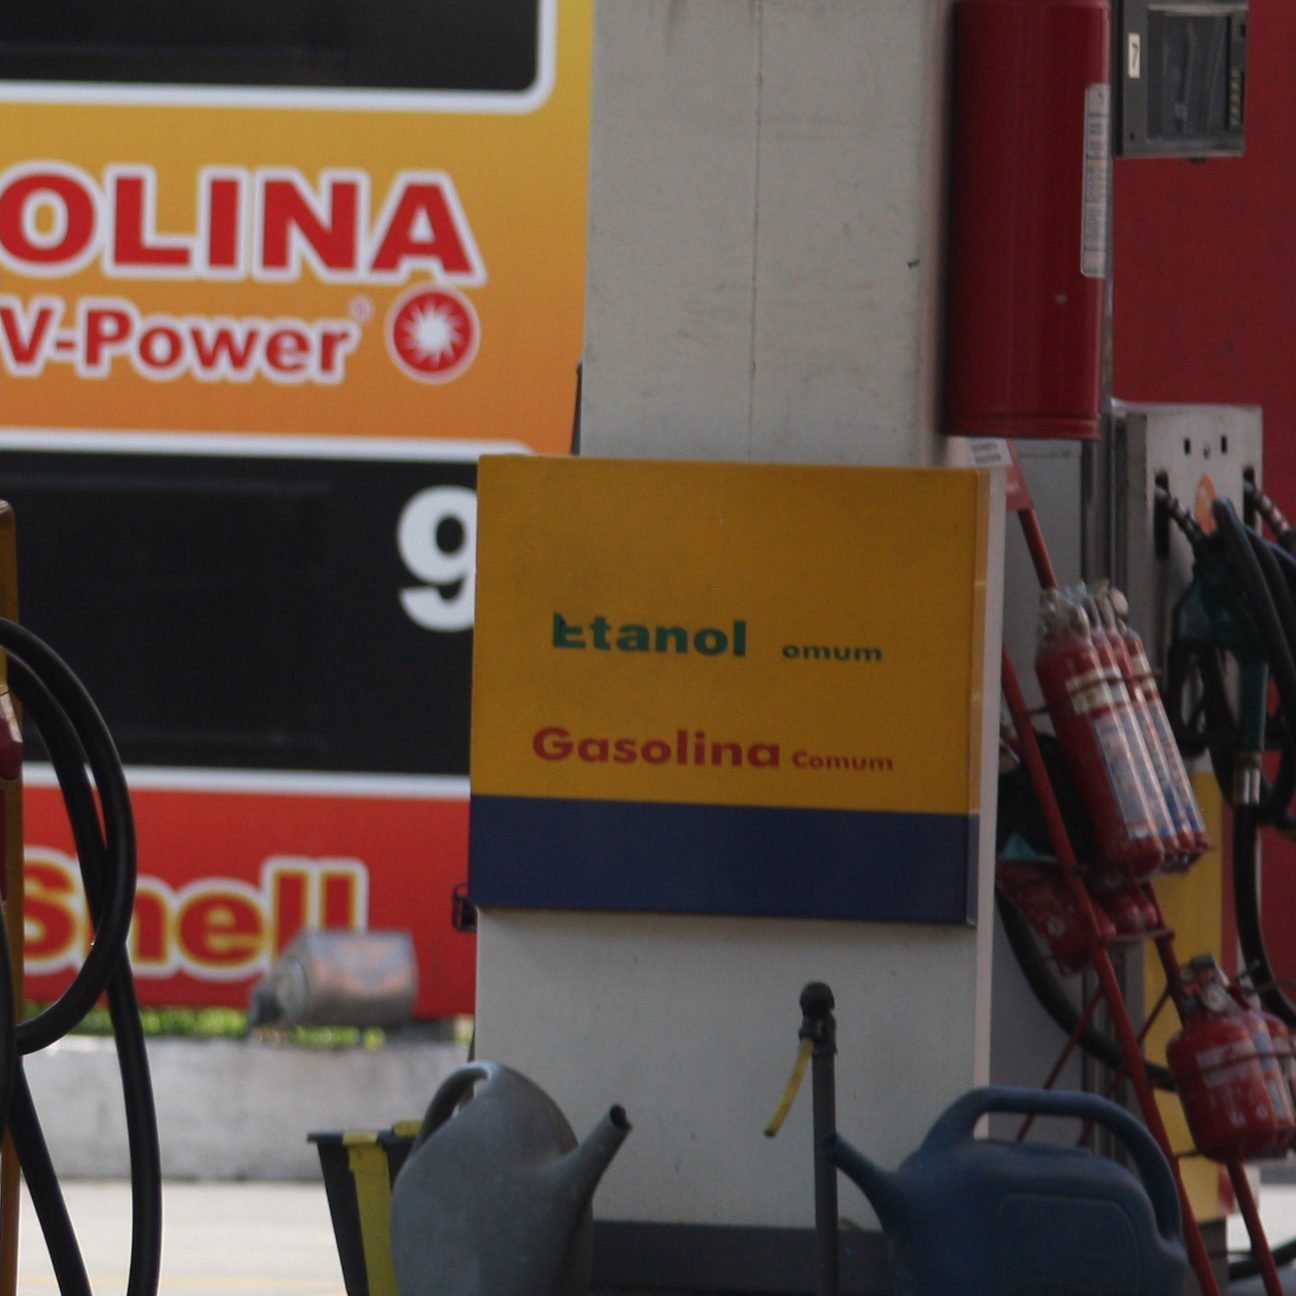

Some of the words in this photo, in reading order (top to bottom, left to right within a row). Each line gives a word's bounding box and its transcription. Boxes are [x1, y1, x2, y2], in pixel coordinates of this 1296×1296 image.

[0, 300, 358, 381] V-Power
[395, 484, 477, 632] 9
[531, 725, 782, 770] Gasolina
[792, 750, 895, 772] Comum
